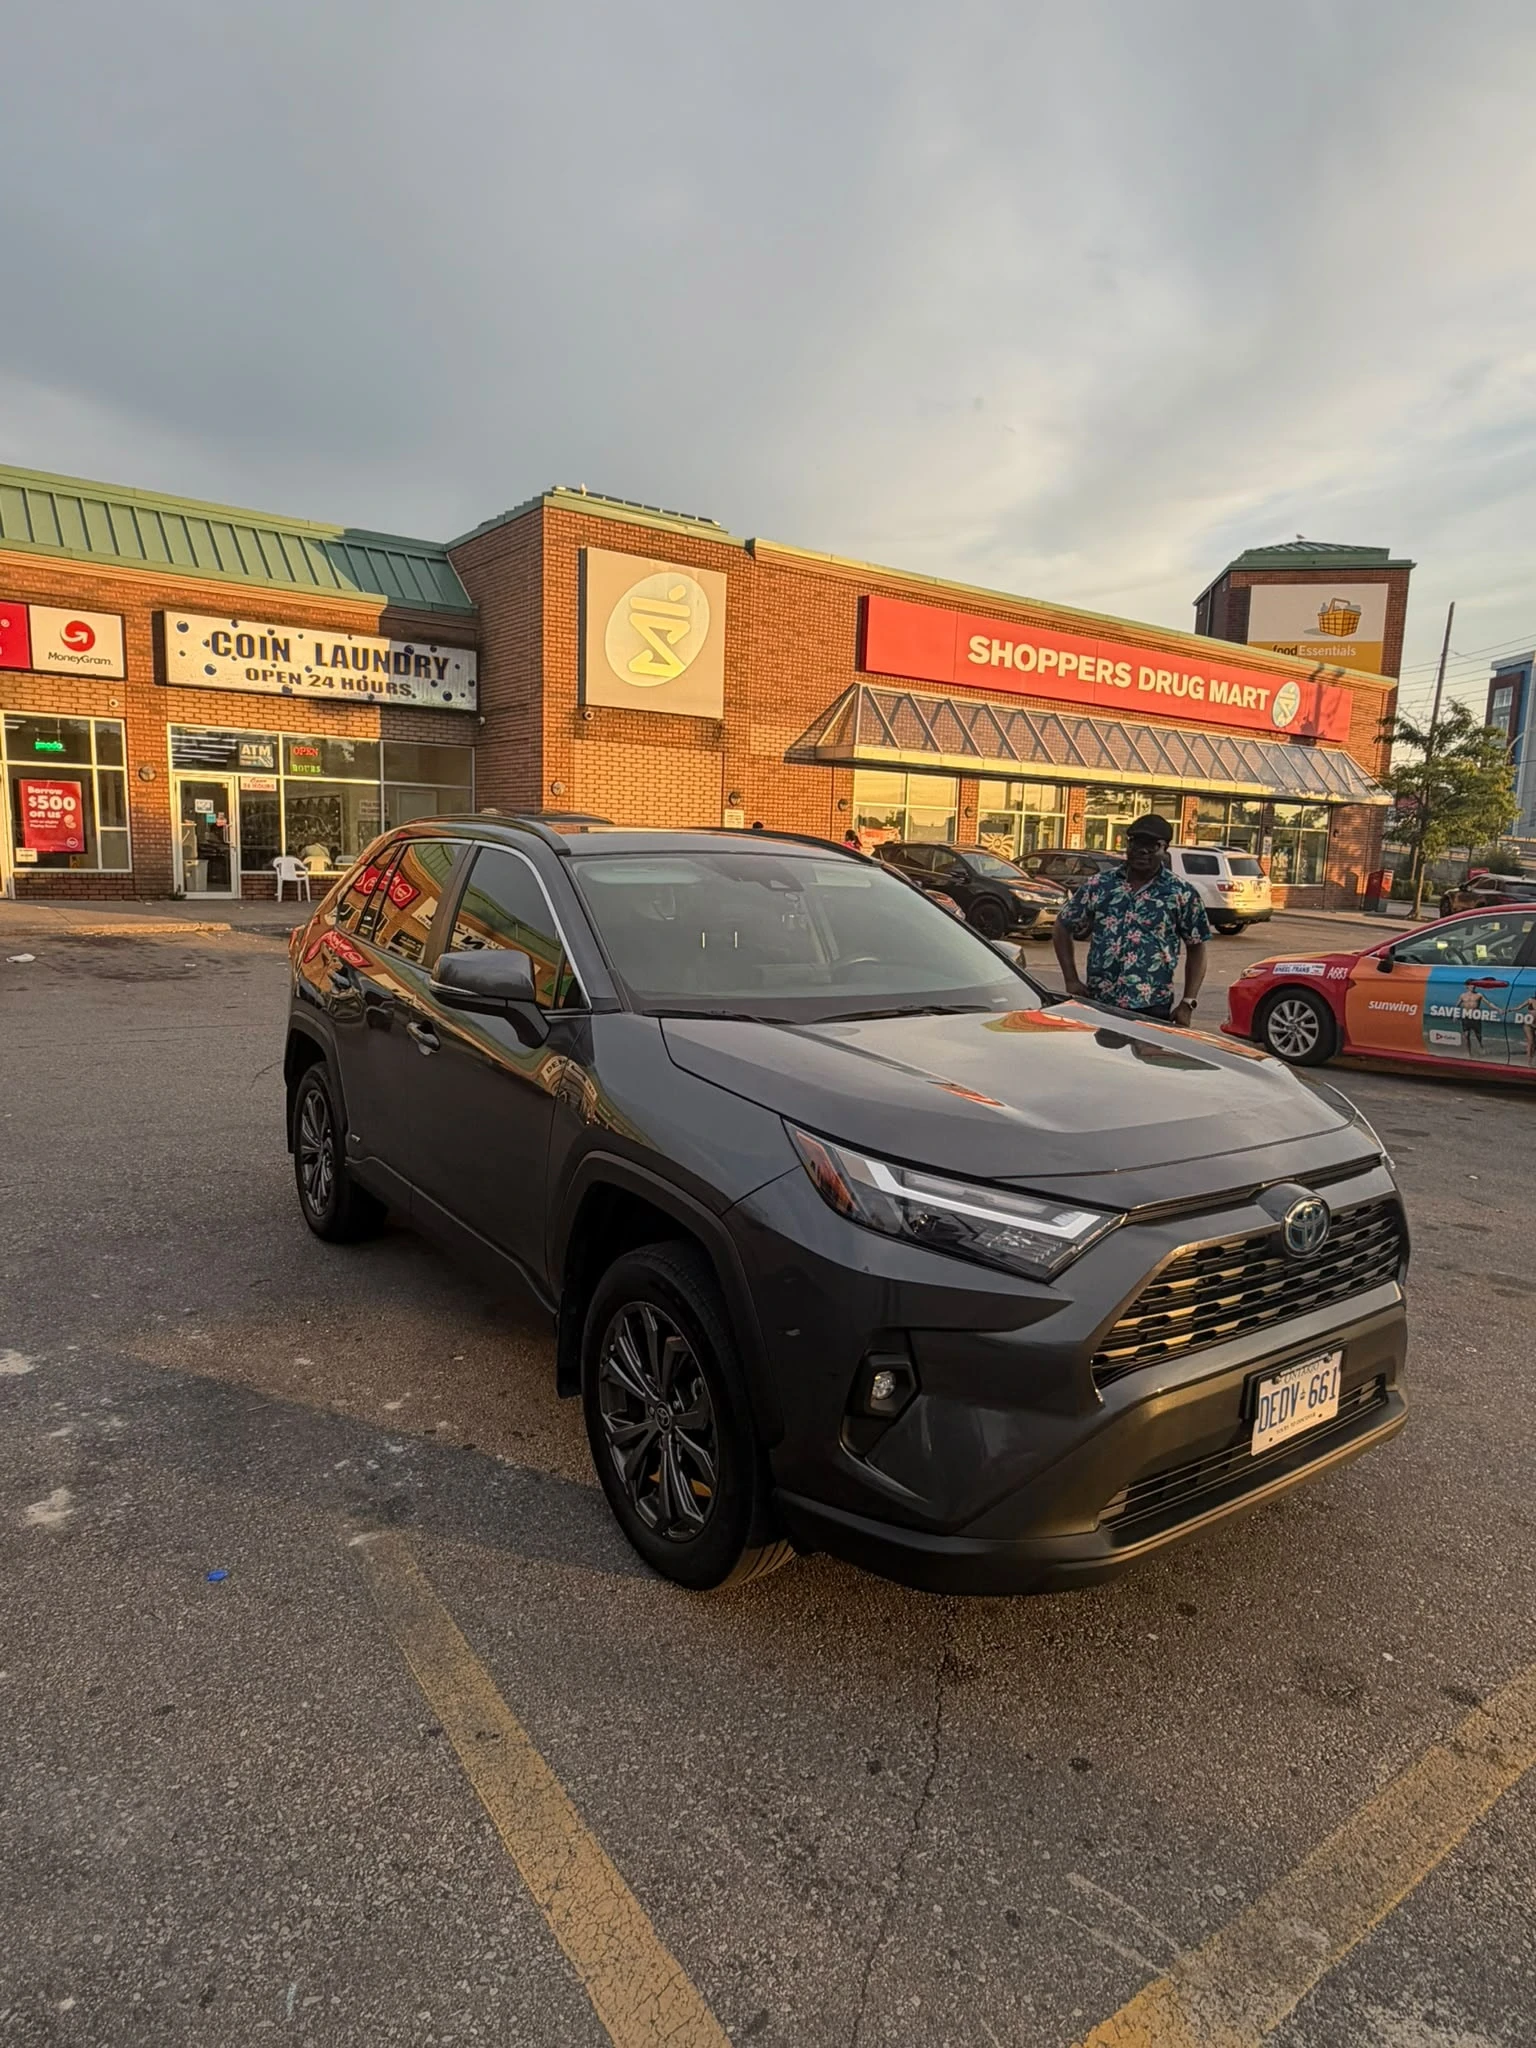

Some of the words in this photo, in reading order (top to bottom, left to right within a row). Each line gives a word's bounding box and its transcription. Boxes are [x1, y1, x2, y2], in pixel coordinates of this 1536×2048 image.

[210, 630, 291, 664] COIN
[315, 642, 450, 681] LAUNDRY
[1299, 645, 1357, 656] Essentials
[245, 667, 302, 686] OPEN
[308, 673, 335, 689] 24
[967, 634, 1132, 689] SHOPPERS
[1138, 666, 1205, 700] DRUG
[1208, 679, 1271, 711] MART
[241, 744, 271, 757] ATM
[292, 746, 319, 758] OPEN
[27, 786, 63, 795] Borrow
[28, 796, 77, 811] $500
[29, 809, 46, 819] on
[1368, 999, 1418, 1015] sunwing
[1430, 1005, 1461, 1018] SAVE
[1462, 1009, 1501, 1021] MORE.
[1514, 1012, 1534, 1025] DO
